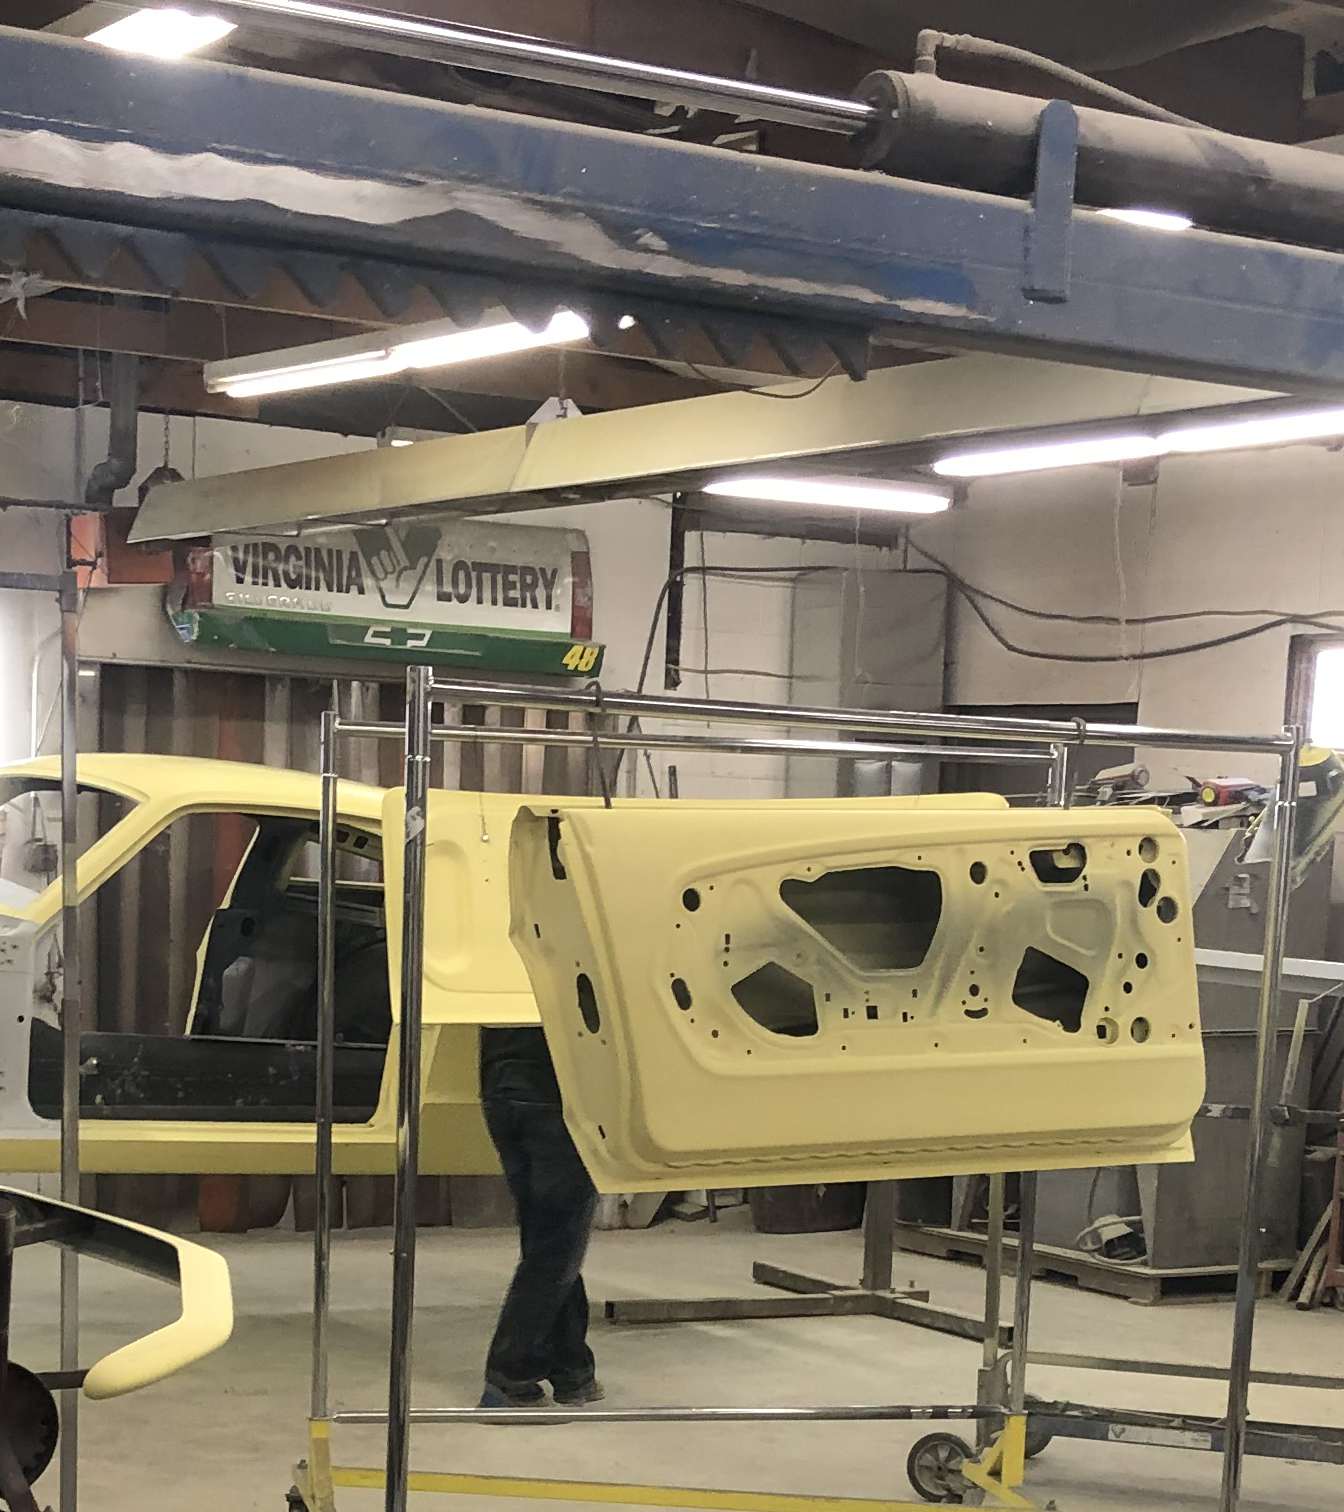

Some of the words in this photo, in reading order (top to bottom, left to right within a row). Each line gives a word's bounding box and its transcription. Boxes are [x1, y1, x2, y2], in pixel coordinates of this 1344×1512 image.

[230, 541, 366, 595] VIRGINIA
[435, 557, 559, 611] LOTTERY
[561, 645, 600, 672] 48
